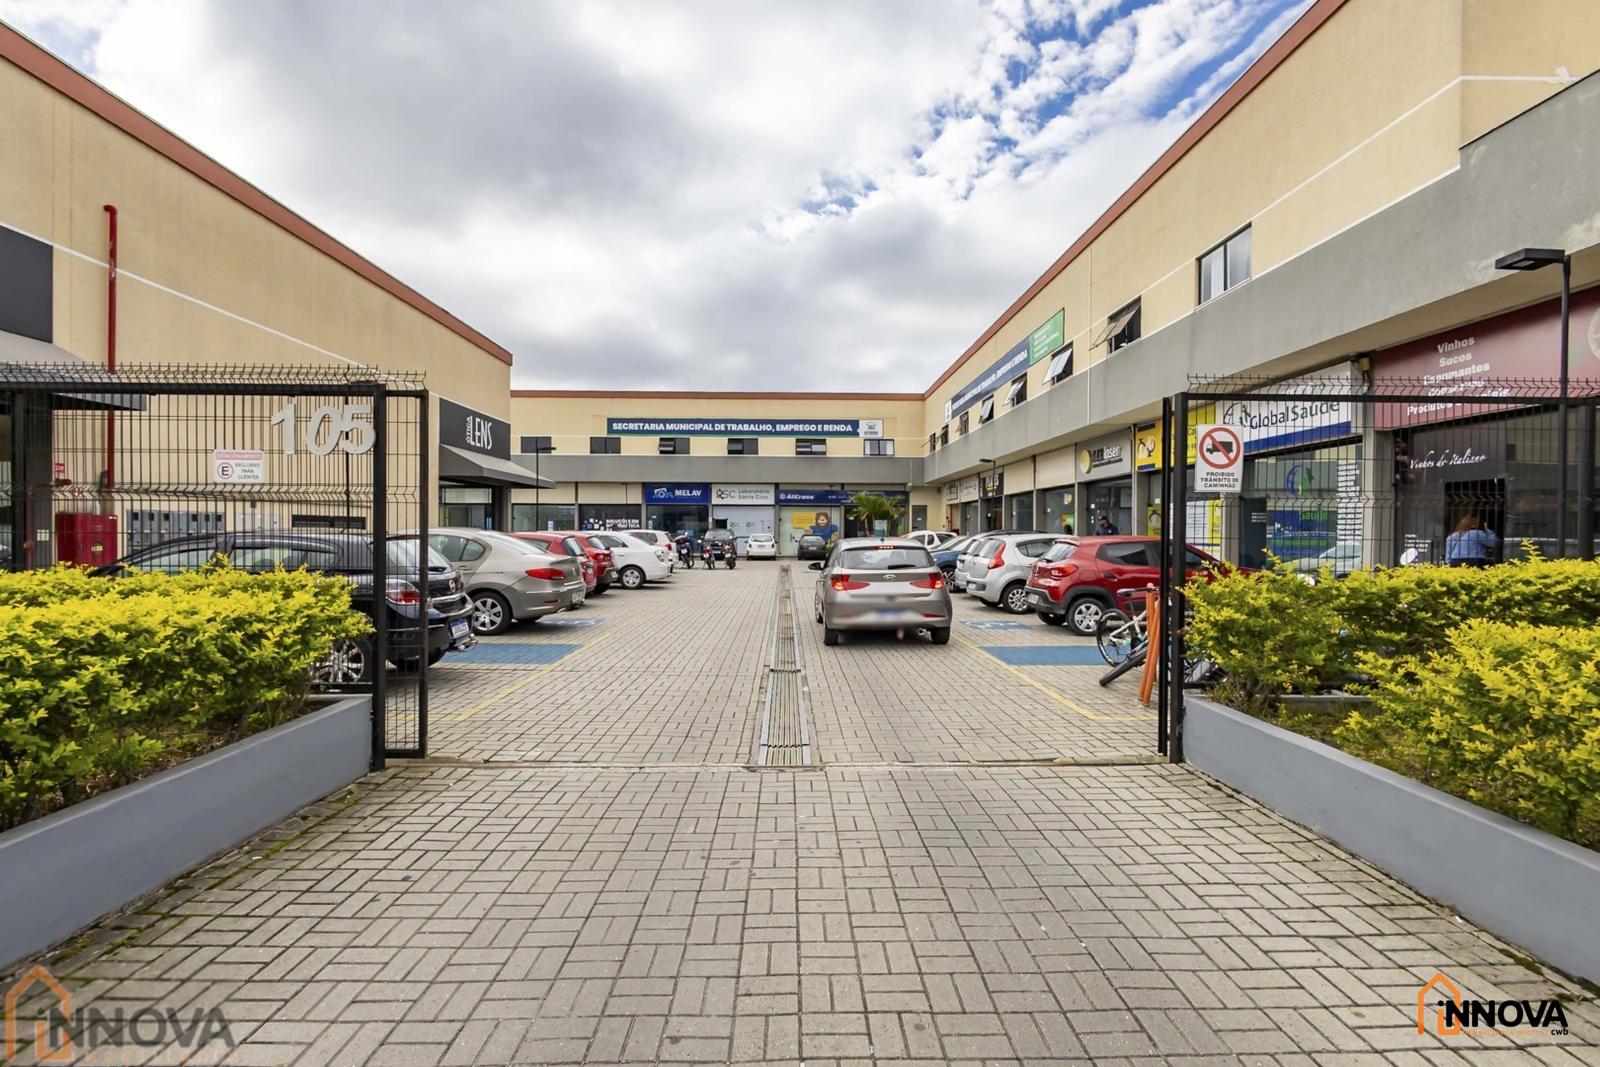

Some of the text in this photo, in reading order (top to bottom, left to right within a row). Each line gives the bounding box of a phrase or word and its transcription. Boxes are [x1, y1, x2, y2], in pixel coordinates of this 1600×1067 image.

[1437, 337, 1475, 353] Vinhos
[1439, 352, 1472, 367] Sucos
[271, 404, 376, 456] 105
[470, 416, 493, 450] LENS
[612, 422, 853, 432] SECRETARIA MUNICIPAL DE TRABALHO, EMPREGO E RENDA
[674, 489, 702, 497] MELAV
